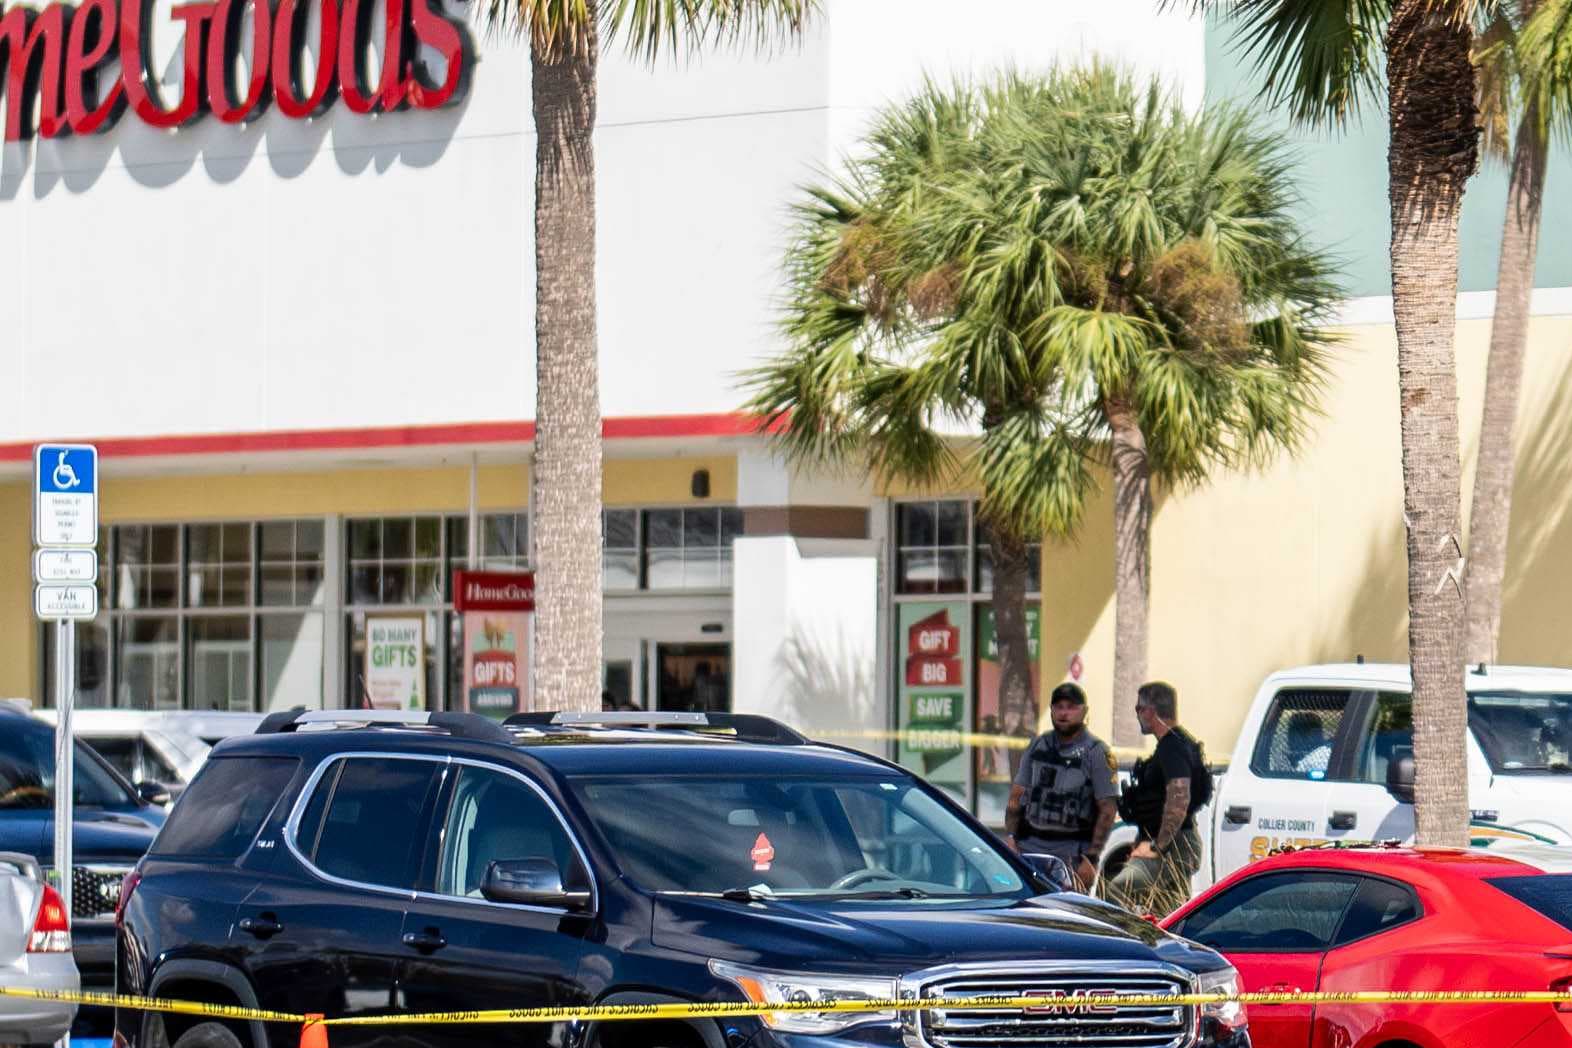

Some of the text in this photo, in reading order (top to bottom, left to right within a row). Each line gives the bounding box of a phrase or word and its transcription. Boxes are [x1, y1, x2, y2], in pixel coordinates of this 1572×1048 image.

[919, 630, 951, 650] GIFT
[372, 645, 417, 668] GIFTS
[474, 661, 515, 682] GIFTS
[922, 663, 947, 683] BIG
[916, 697, 953, 717] SAVE
[1258, 818, 1315, 832] COLLIER COUNTY
[1021, 989, 1117, 1015] GMC
